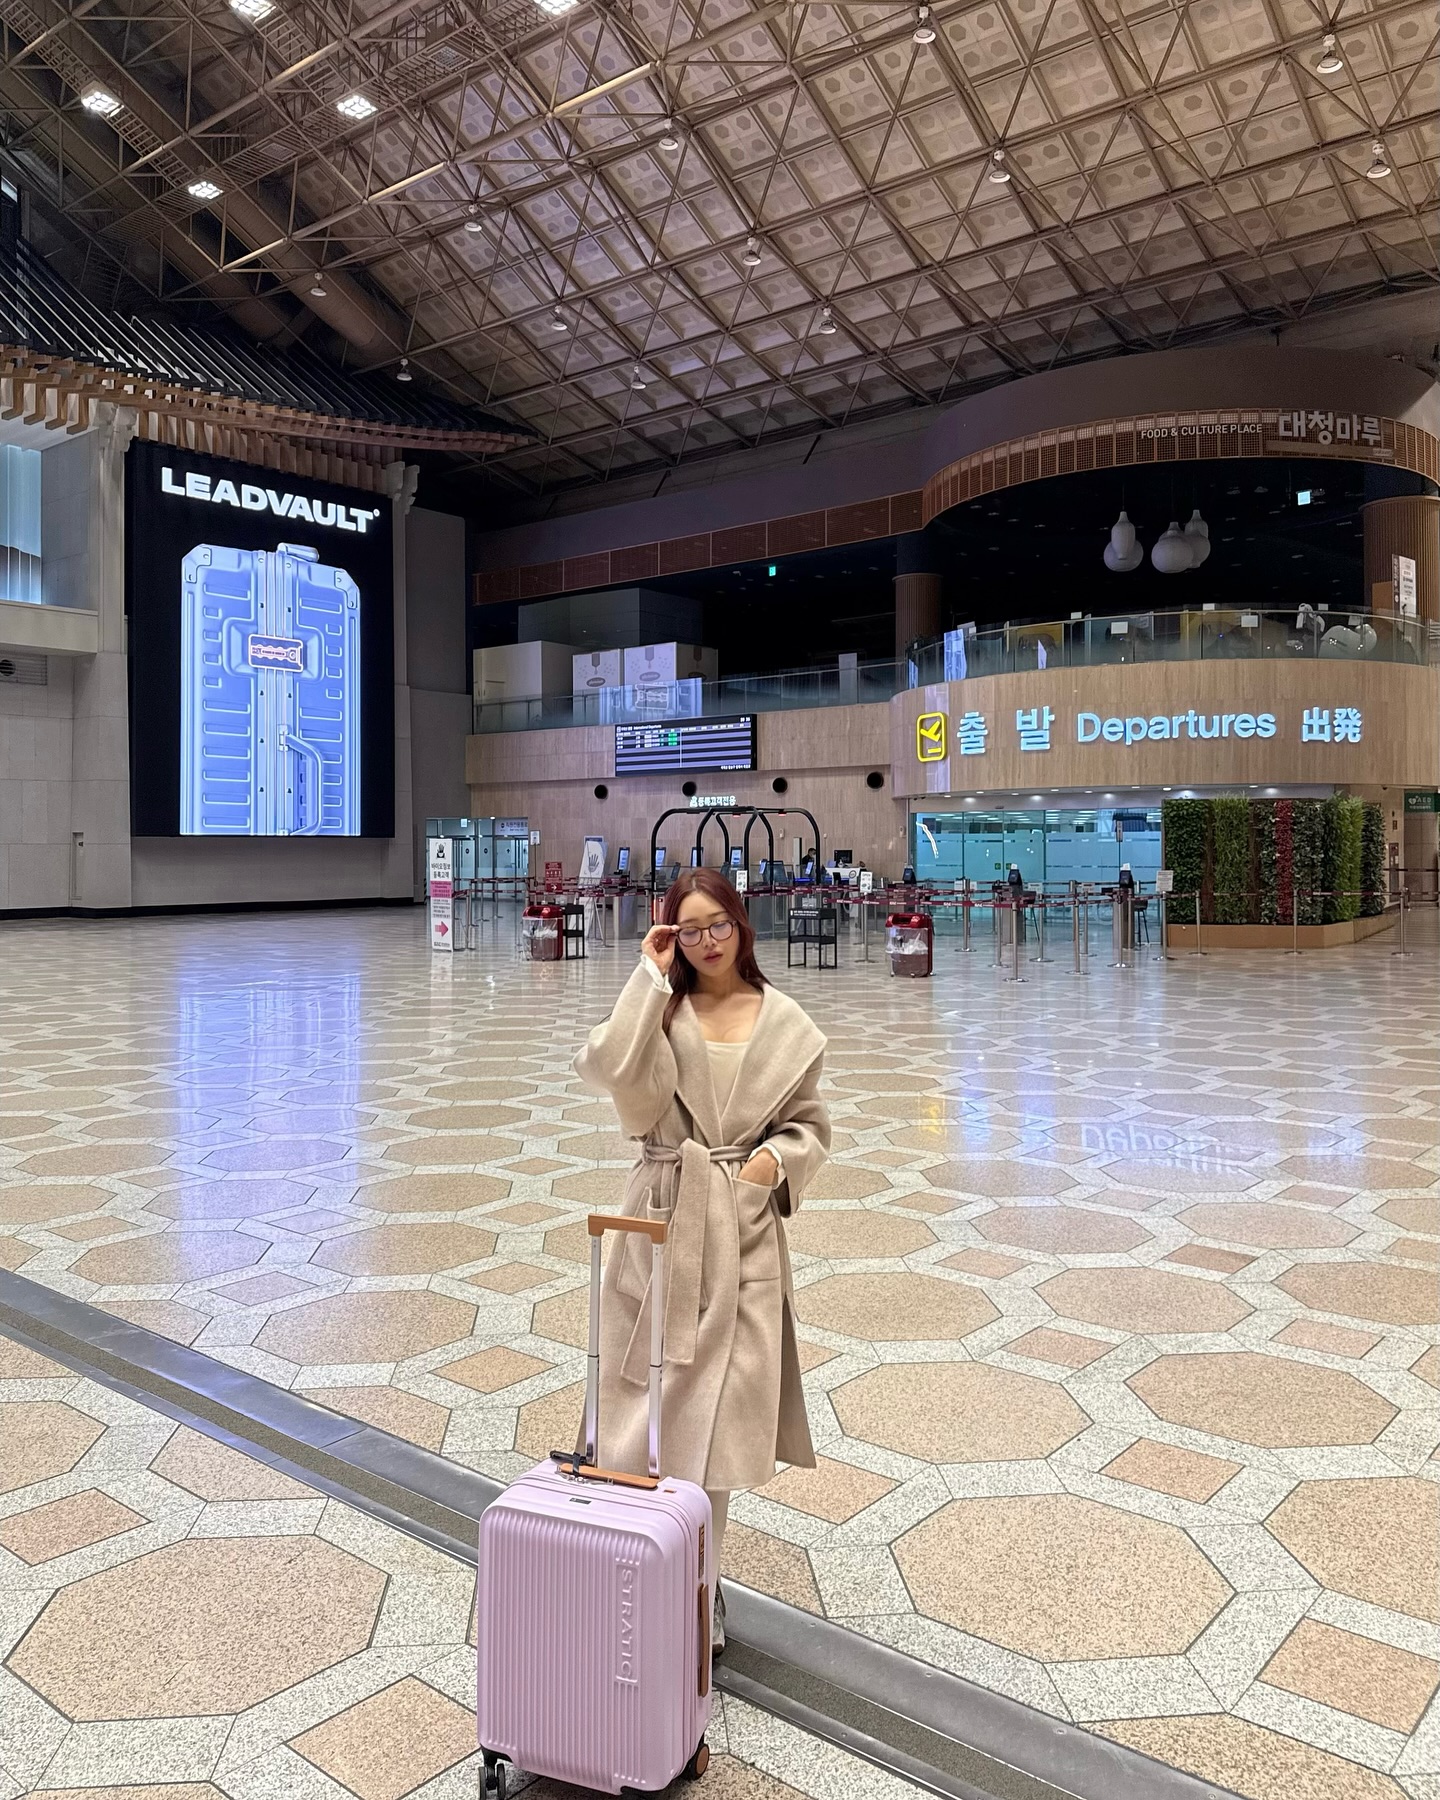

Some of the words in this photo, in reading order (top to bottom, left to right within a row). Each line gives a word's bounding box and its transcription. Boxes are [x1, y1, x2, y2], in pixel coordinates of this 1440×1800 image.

[1141, 427, 1168, 439] FOOD
[1170, 427, 1178, 437] &
[1181, 424, 1229, 437] CULTURE
[1230, 423, 1263, 434] PLACE
[1278, 410, 1382, 446] 대청마루
[1077, 709, 1277, 745] Departures
[1302, 706, 1363, 744] 出発
[621, 1568, 633, 1678] STRATIC
